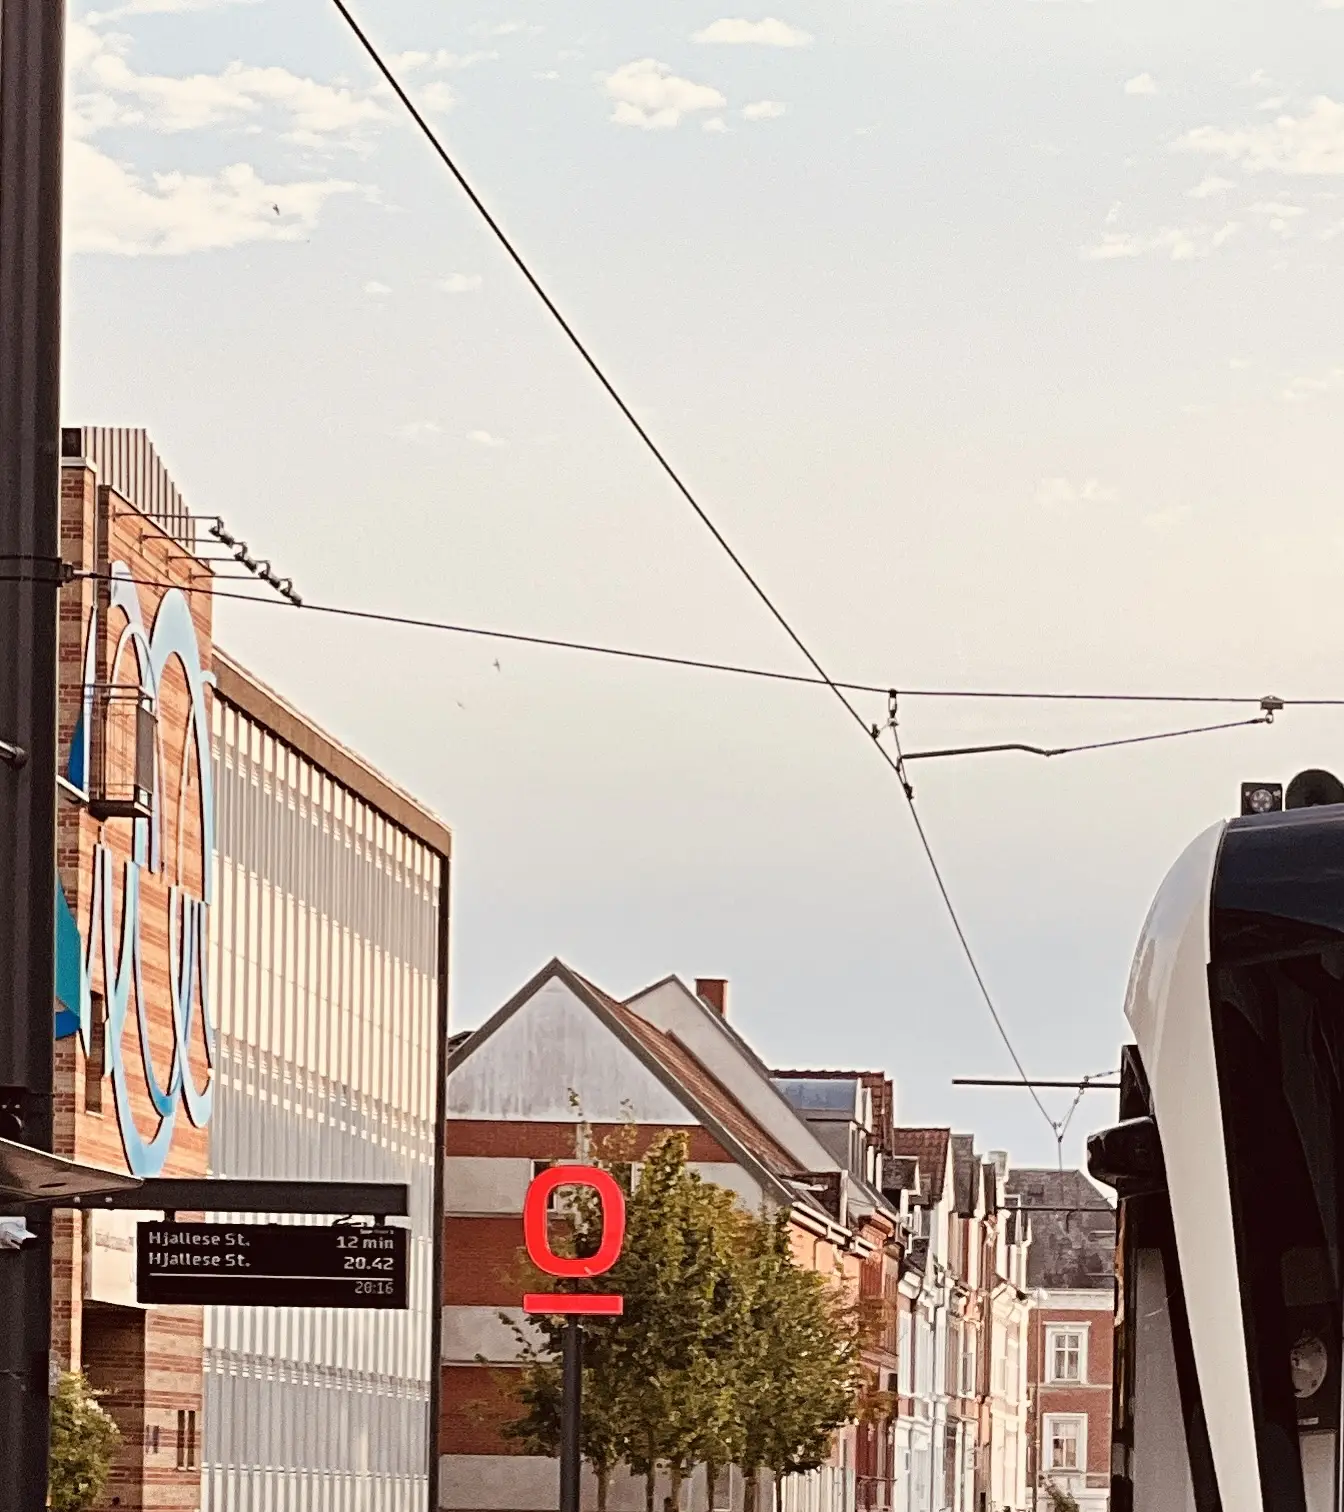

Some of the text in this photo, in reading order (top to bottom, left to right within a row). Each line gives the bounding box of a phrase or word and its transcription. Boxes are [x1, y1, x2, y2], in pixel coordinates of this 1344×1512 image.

[149, 1232, 394, 1249] Hjallese St. 12 min
[149, 1252, 394, 1270] Hjallese St. 20.42
[355, 1281, 394, 1294] 20:16
